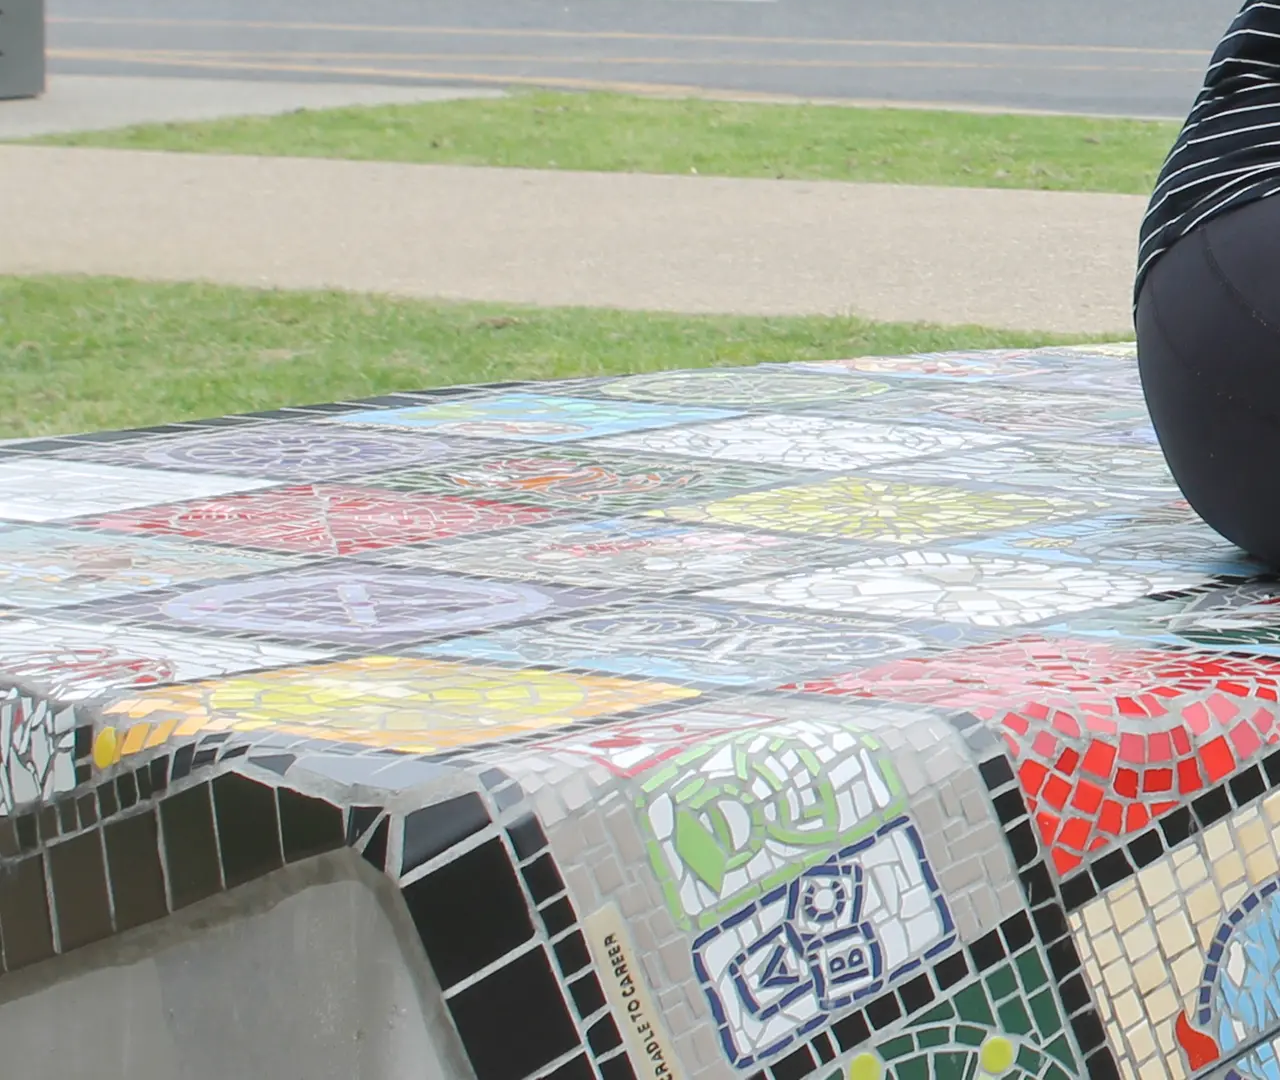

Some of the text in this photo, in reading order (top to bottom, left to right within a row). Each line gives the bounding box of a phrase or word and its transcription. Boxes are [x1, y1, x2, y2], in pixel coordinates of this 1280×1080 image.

[604, 932, 636, 998] CAREER
[760, 945, 799, 987] A
[830, 948, 870, 984] B
[627, 1000, 643, 1023] TO
